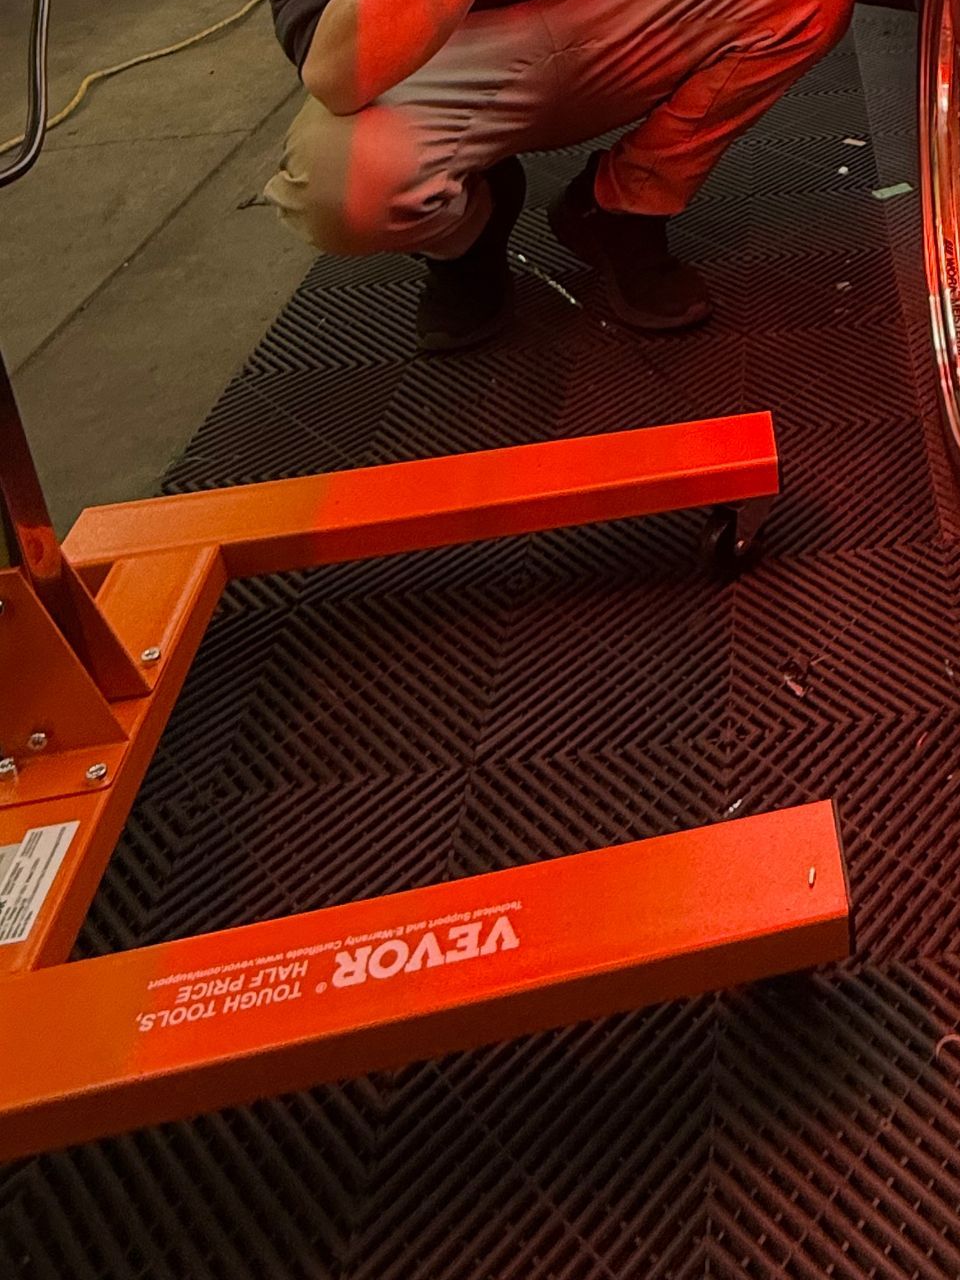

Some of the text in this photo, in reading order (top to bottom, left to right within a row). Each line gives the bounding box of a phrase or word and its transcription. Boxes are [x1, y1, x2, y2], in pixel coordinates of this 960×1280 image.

[428, 910, 472, 929] Support
[472, 900, 523, 920] Technical
[344, 926, 404, 946] E-Warranty
[405, 920, 427, 934] and
[286, 940, 343, 959] Certificate
[331, 915, 521, 988] VEVOR
[174, 959, 309, 1004] HALF PRICE
[135, 980, 302, 1032] TOUGH TOOLS,
